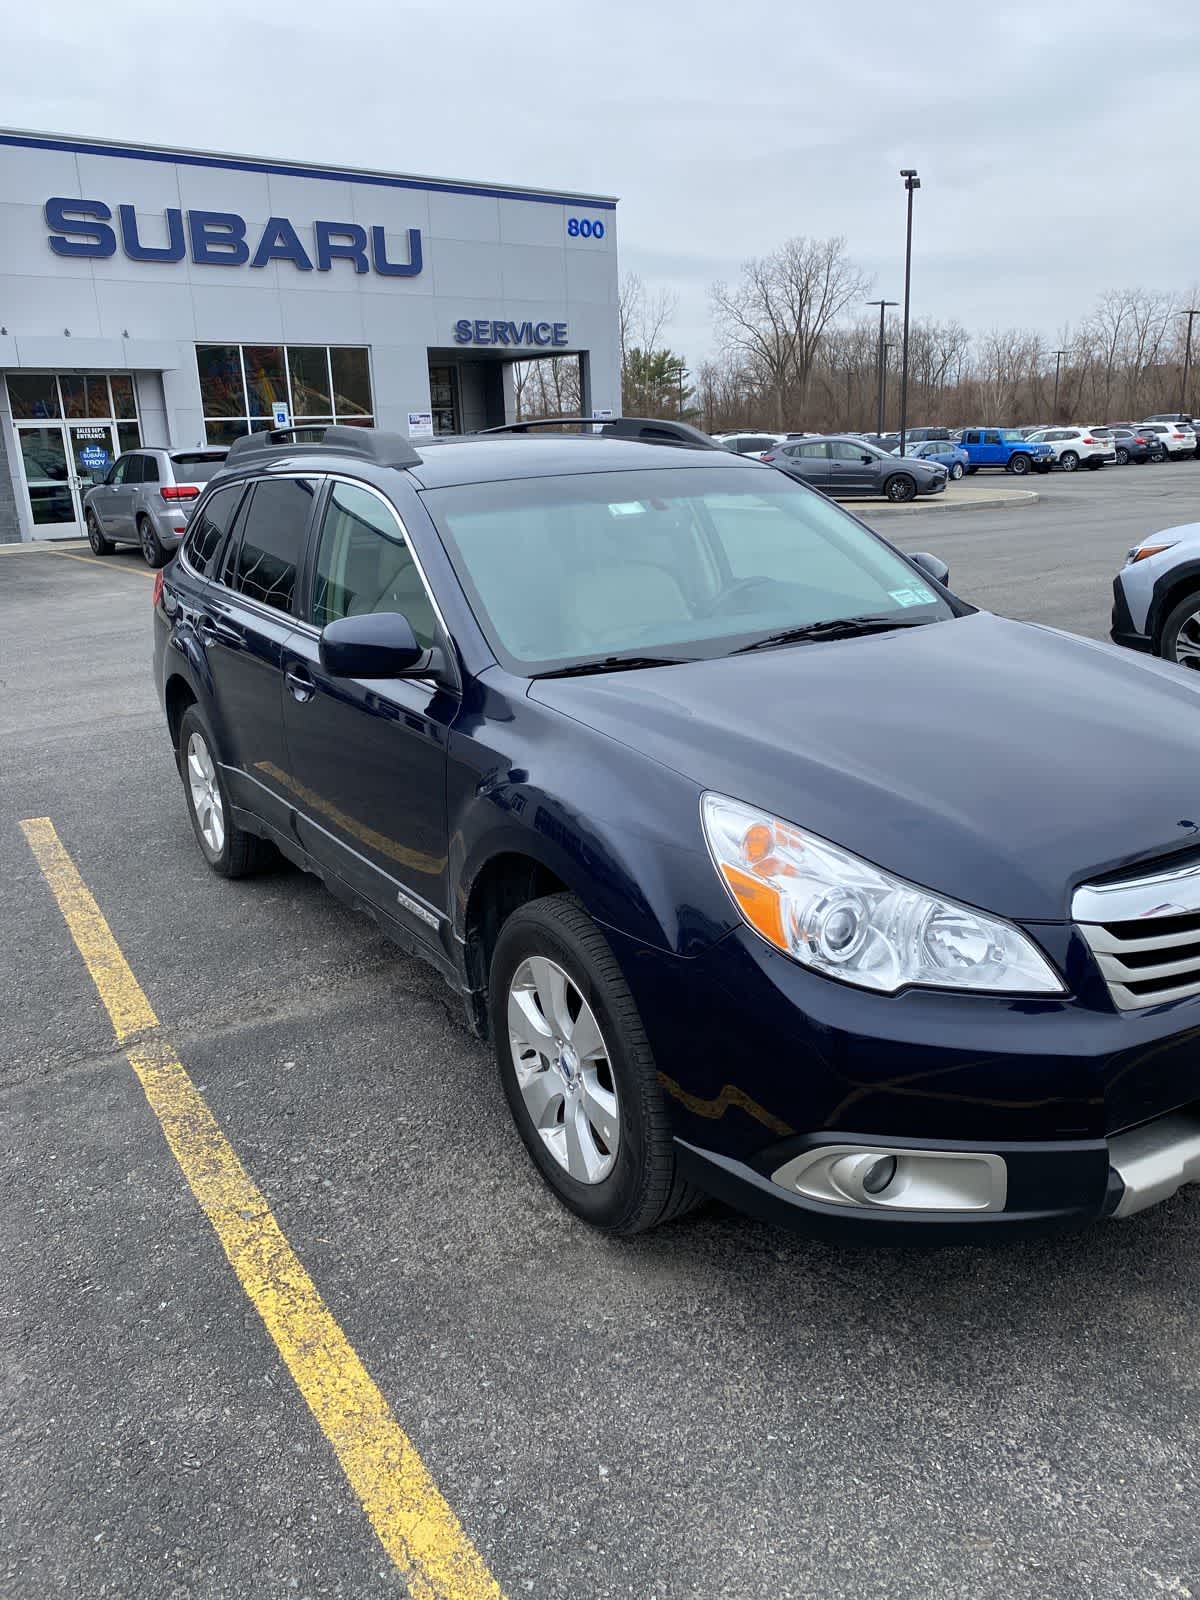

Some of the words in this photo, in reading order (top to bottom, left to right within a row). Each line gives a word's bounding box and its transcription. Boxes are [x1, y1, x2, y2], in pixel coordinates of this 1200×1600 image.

[45, 197, 423, 277] SUBARU
[567, 218, 605, 239] 800
[454, 319, 569, 346] SERVICE
